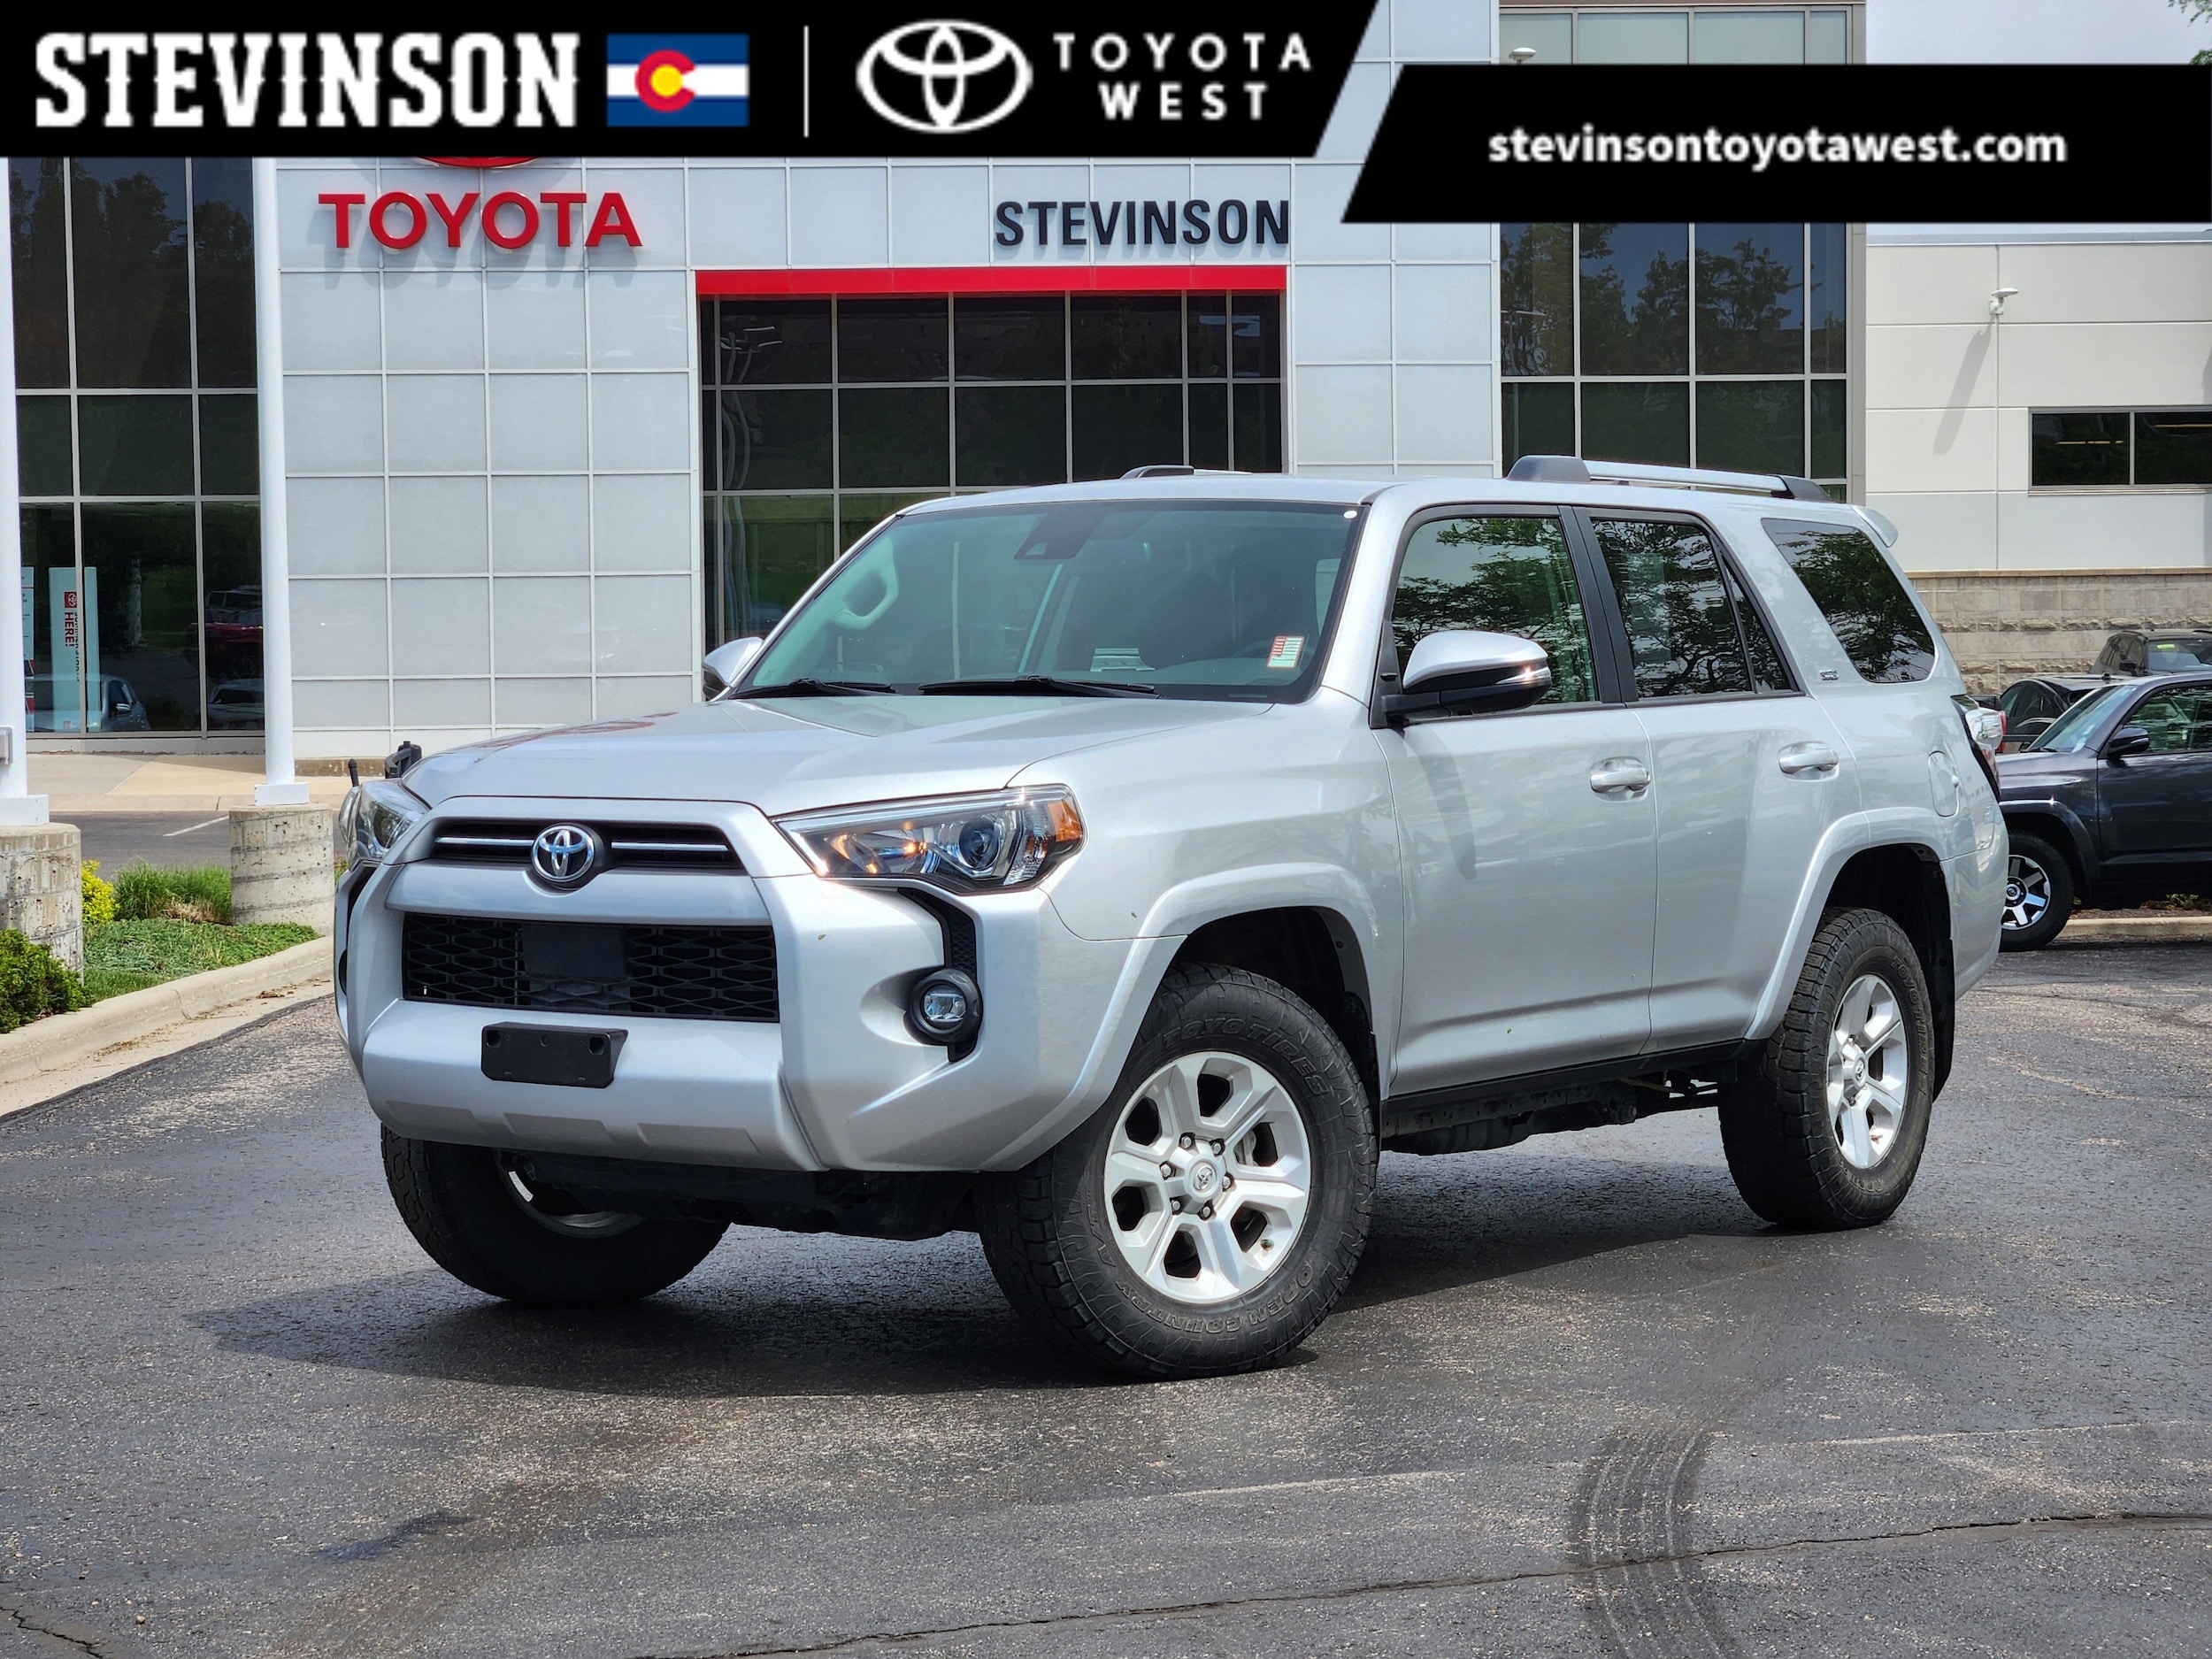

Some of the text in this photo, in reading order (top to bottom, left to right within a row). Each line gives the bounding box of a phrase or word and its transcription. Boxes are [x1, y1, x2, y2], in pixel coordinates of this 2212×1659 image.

[319, 191, 643, 249] TOYOTA
[995, 199, 1289, 248] STEVINSON
[65, 611, 75, 647] HERE!
[1164, 1018, 1332, 1095] TOYO TIRES
[1114, 1260, 1315, 1335] OPEN COUNTRY
